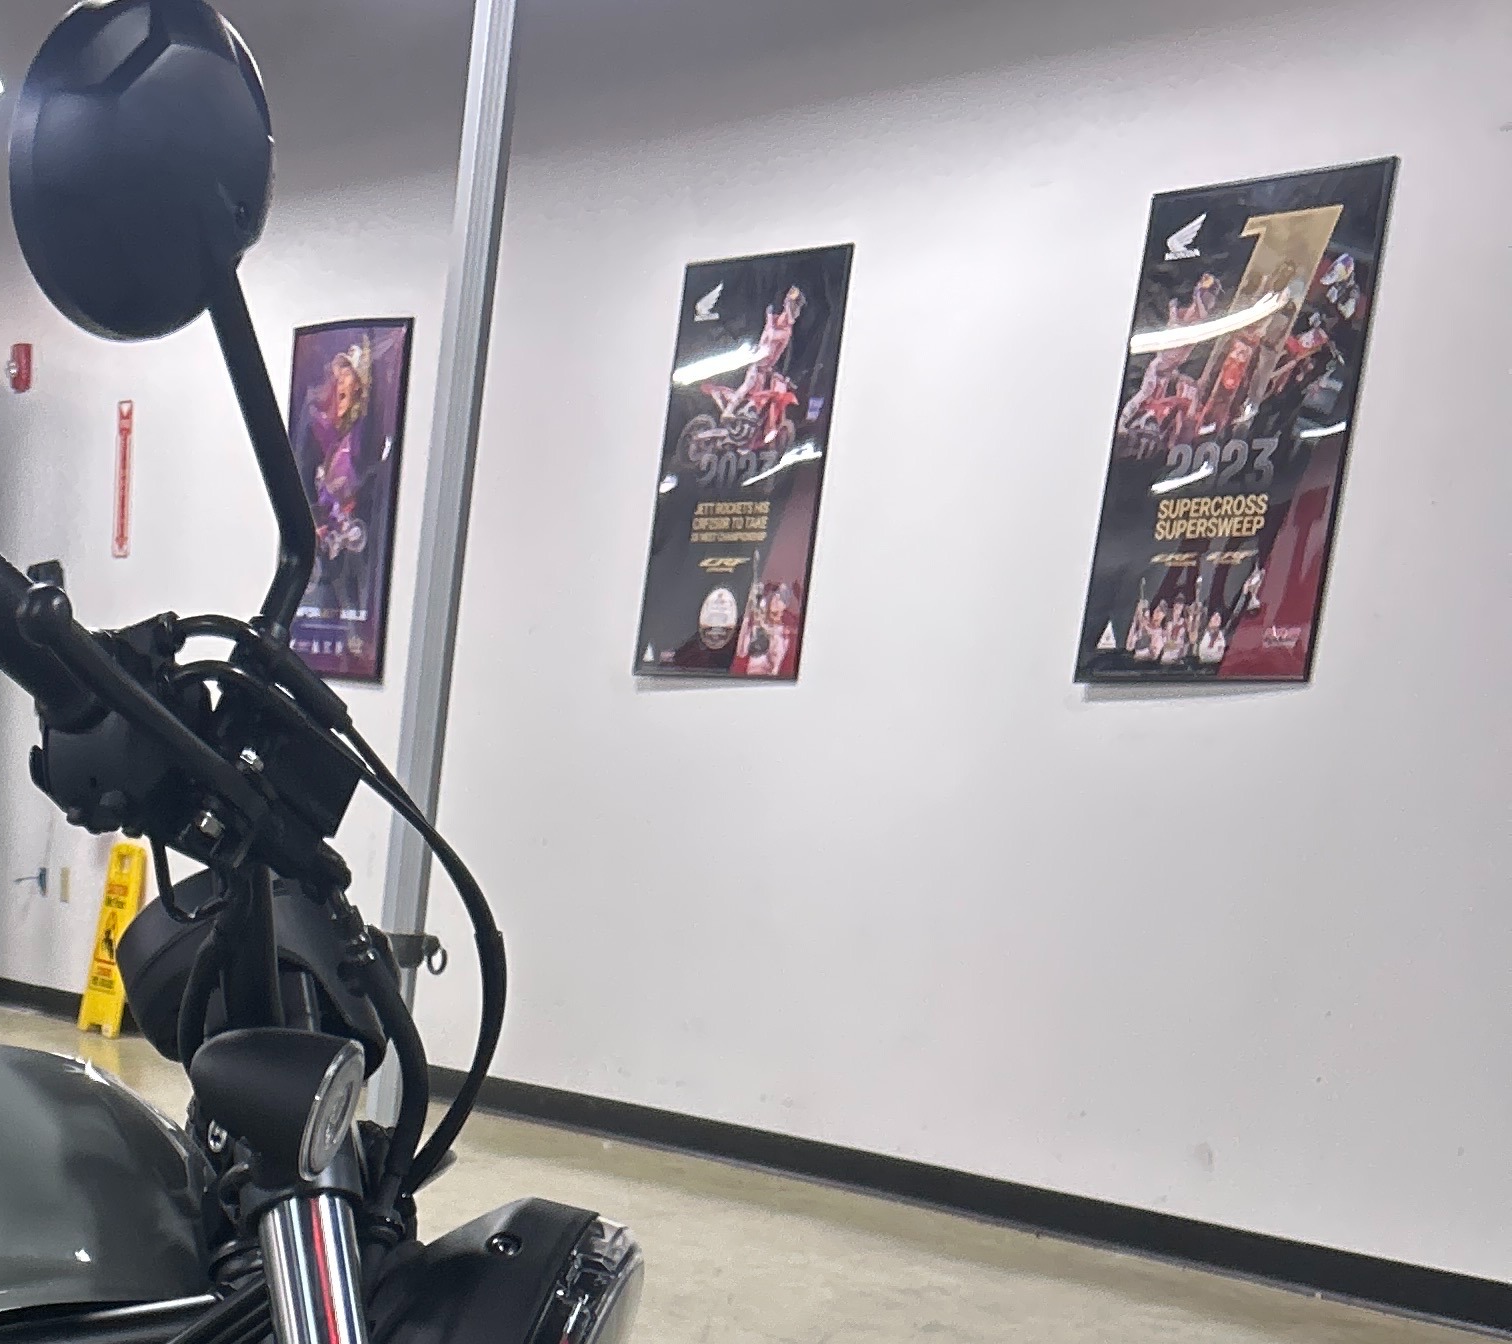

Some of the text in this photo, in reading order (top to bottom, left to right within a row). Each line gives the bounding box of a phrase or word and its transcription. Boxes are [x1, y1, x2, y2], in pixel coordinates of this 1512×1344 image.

[1166, 434, 1279, 491] 2023
[1158, 494, 1268, 519] SUPERCROSS
[1154, 516, 1265, 540] SUPERSWEEP
